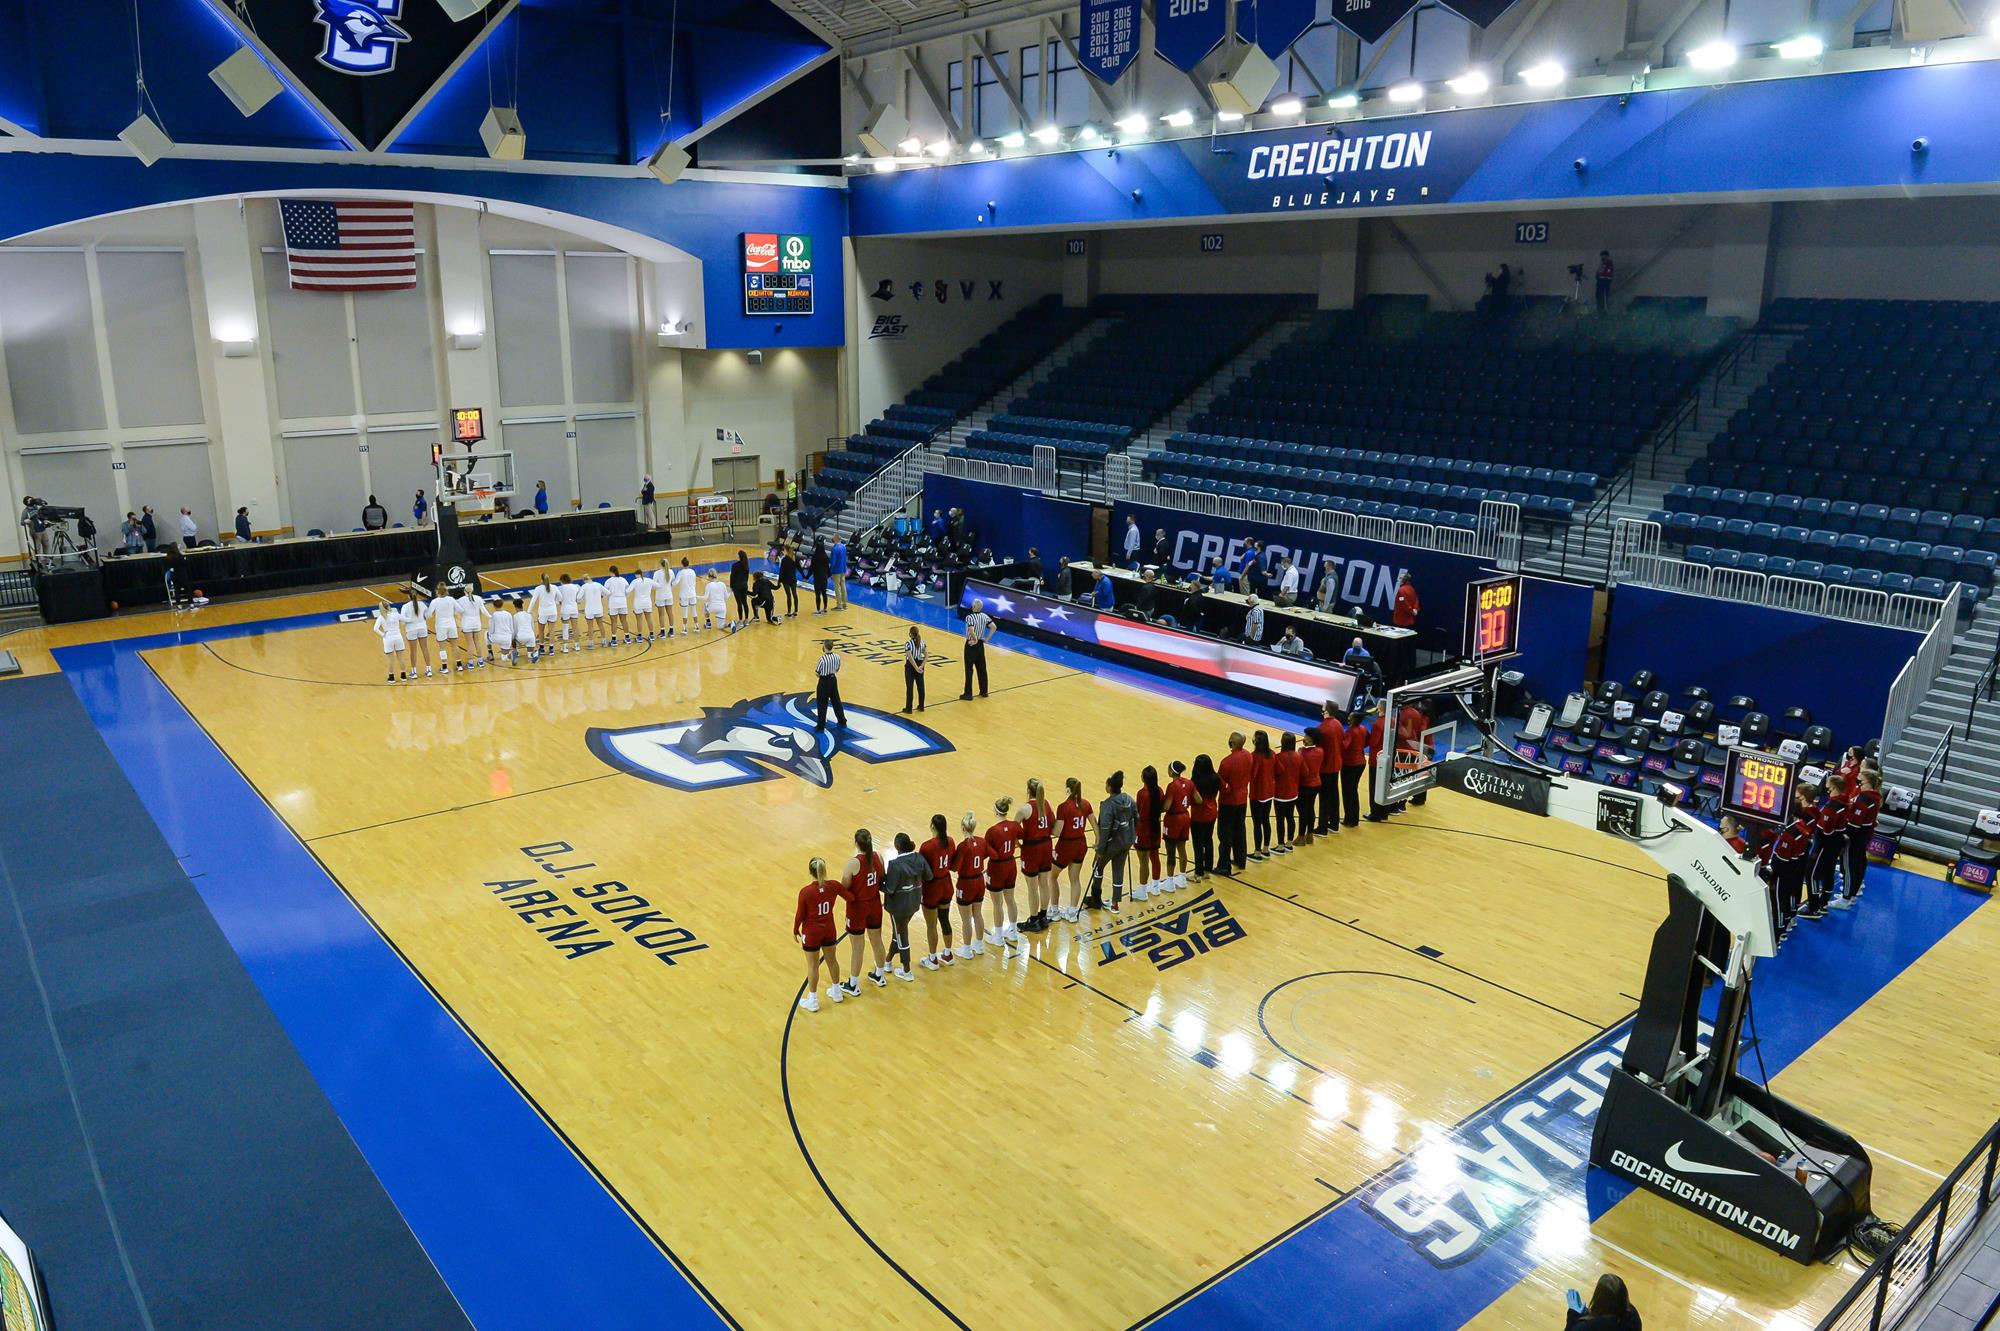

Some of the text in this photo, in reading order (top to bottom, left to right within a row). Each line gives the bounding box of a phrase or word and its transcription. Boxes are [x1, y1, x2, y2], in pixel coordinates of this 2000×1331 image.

[1091, 6, 1132, 24] 2010 2015
[1090, 18, 1132, 35] 2012 2016
[1090, 30, 1131, 46] 2013 2017
[1089, 41, 1130, 58] 2014 2018
[1101, 56, 1120, 69] 2019
[1248, 131, 1432, 179] CREIGHTON
[1272, 188, 1396, 208] BLUEJAYS
[1517, 224, 1546, 241] 103
[746, 243, 777, 256] Coca-Cola
[1069, 241, 1084, 253] 101
[1203, 236, 1222, 250] 102
[782, 256, 811, 270] fnbo
[875, 315, 902, 325] BIG
[871, 325, 908, 335] EAST
[456, 410, 480, 421] 10:00
[458, 420, 478, 437] 30
[1481, 586, 1512, 610] 10:00
[1480, 610, 1506, 650] 30
[1470, 768, 1525, 792] GETTMAN
[1743, 760, 1787, 785] 10:00
[1476, 781, 1512, 798] MILLS
[1743, 781, 1775, 809] 30
[1181, 795, 1188, 807] 4
[1038, 815, 1048, 829] 31
[1073, 815, 1084, 829] 34
[1003, 840, 1011, 854] 11
[519, 840, 598, 879] D.J.
[938, 854, 948, 869] 14
[973, 855, 980, 869] 0
[867, 871, 877, 887] 21
[1690, 859, 1731, 902] SPALDING
[818, 901, 829, 915] 10
[482, 878, 616, 960] ARENA
[571, 880, 711, 967] SOKOL
[1097, 898, 1231, 967] EAST
[1147, 916, 1248, 972] BIG
[1609, 1149, 1801, 1251] GOCREIGHTON.COM
